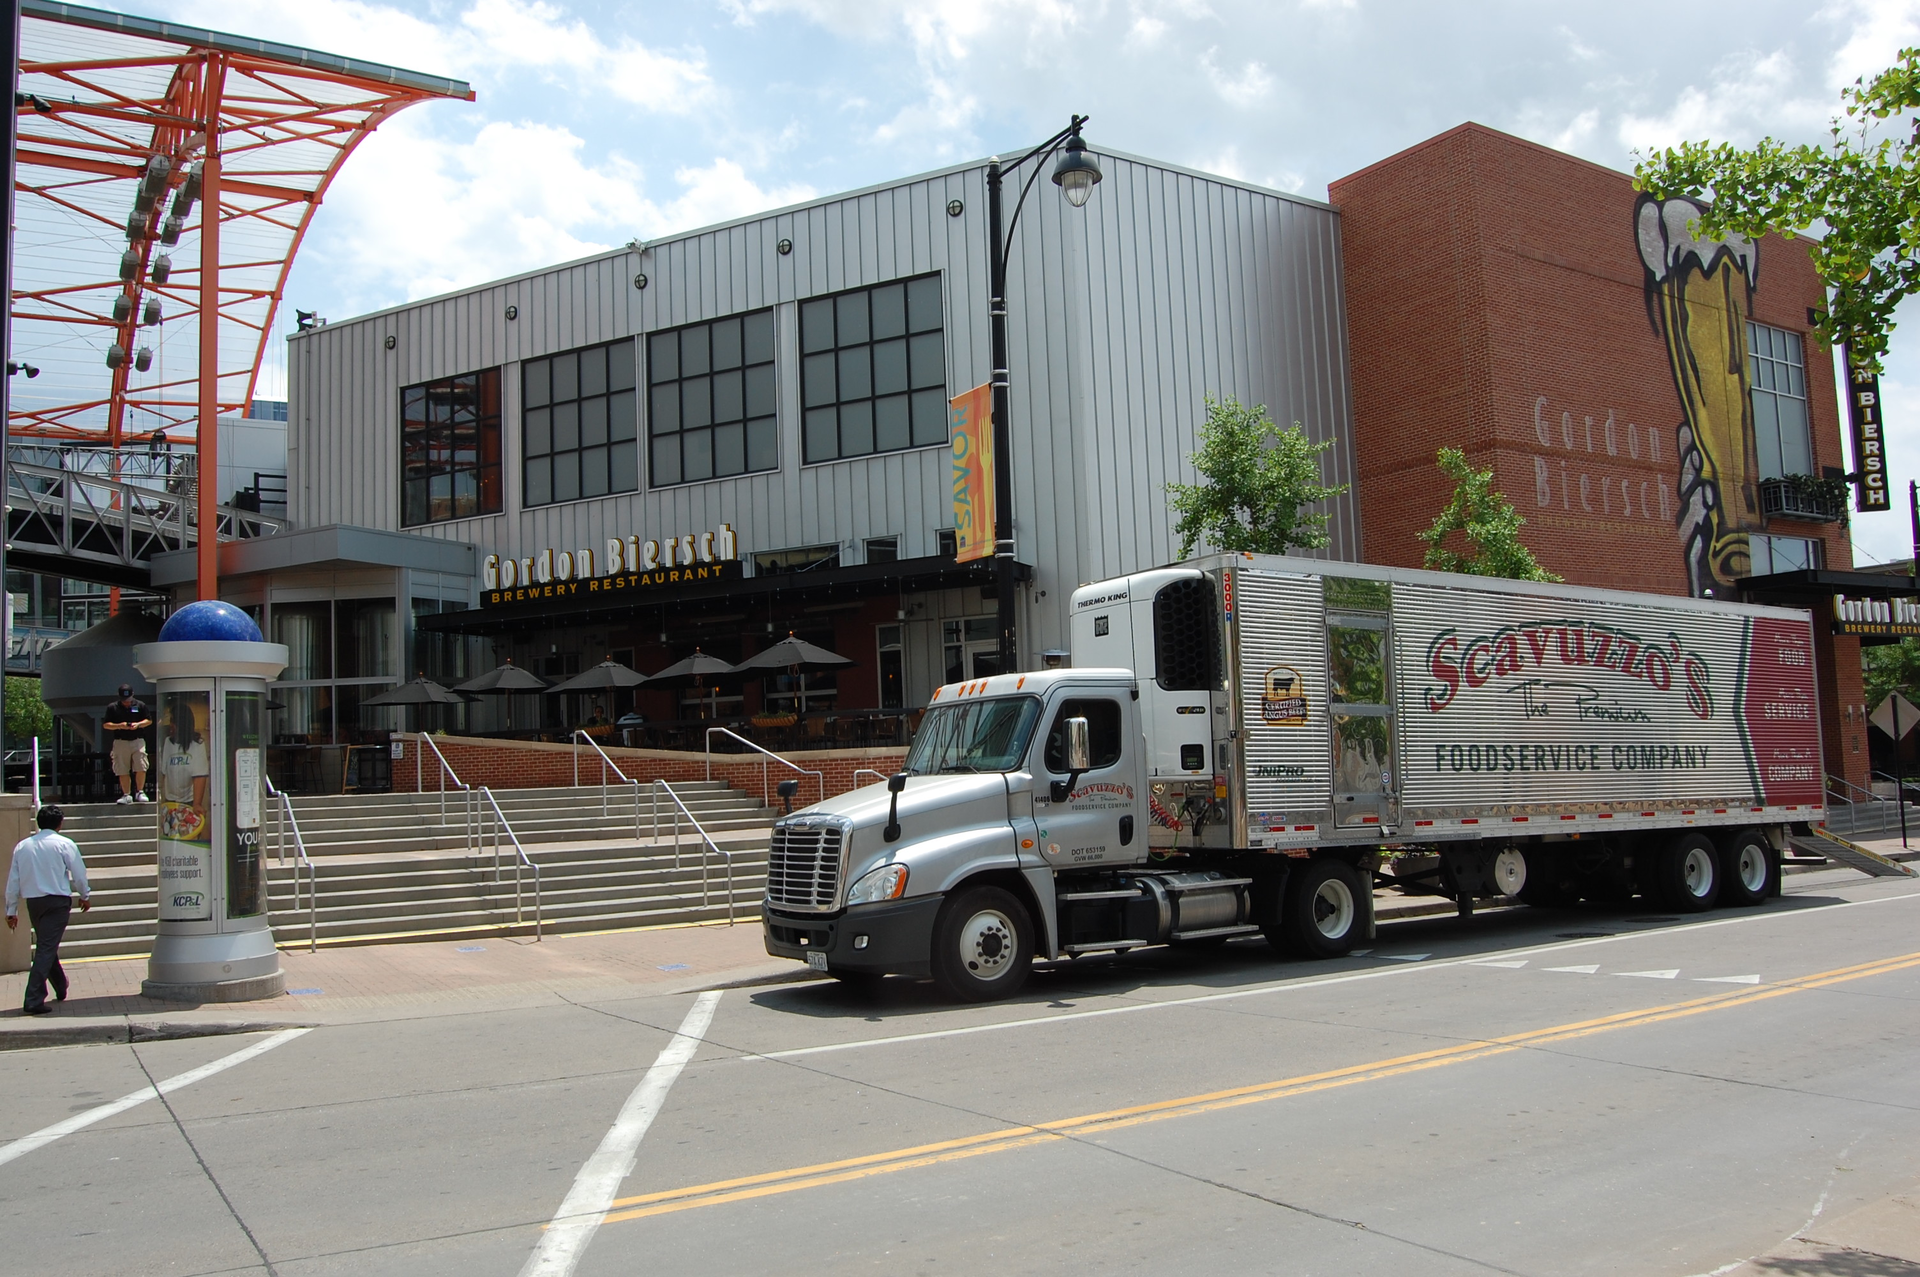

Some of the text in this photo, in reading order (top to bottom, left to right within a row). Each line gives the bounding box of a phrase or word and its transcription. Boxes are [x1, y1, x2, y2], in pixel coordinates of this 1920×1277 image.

[1534, 396, 1662, 462] Gordon
[1857, 392, 1885, 505] BIERSCH
[952, 404, 972, 531] SAVOR
[1534, 455, 1670, 520] Biersch
[483, 523, 738, 590] Gordon Biersch
[491, 565, 723, 603] BREWERY RESTAURANT
[1077, 592, 1128, 609] THERMO KING
[1833, 594, 1890, 623] Gordon
[1844, 624, 1887, 633] BREWERY
[1779, 648, 1805, 666] FOOD
[1424, 619, 1714, 720] Scavuzzo's
[1265, 699, 1302, 710] CERTIFIED
[1507, 679, 1651, 722] The Premium
[1263, 709, 1288, 718] ANGUS
[1764, 702, 1809, 720] SERVICE
[1435, 744, 1709, 772] FOODSERVICE COMPANY
[1768, 764, 1813, 782] COMPANY
[1071, 803, 1107, 811] FOODSERVICE
[236, 831, 258, 845] YOU
[172, 855, 199, 866] charitable
[180, 869, 203, 879] support.
[173, 895, 201, 907] KCP&L
